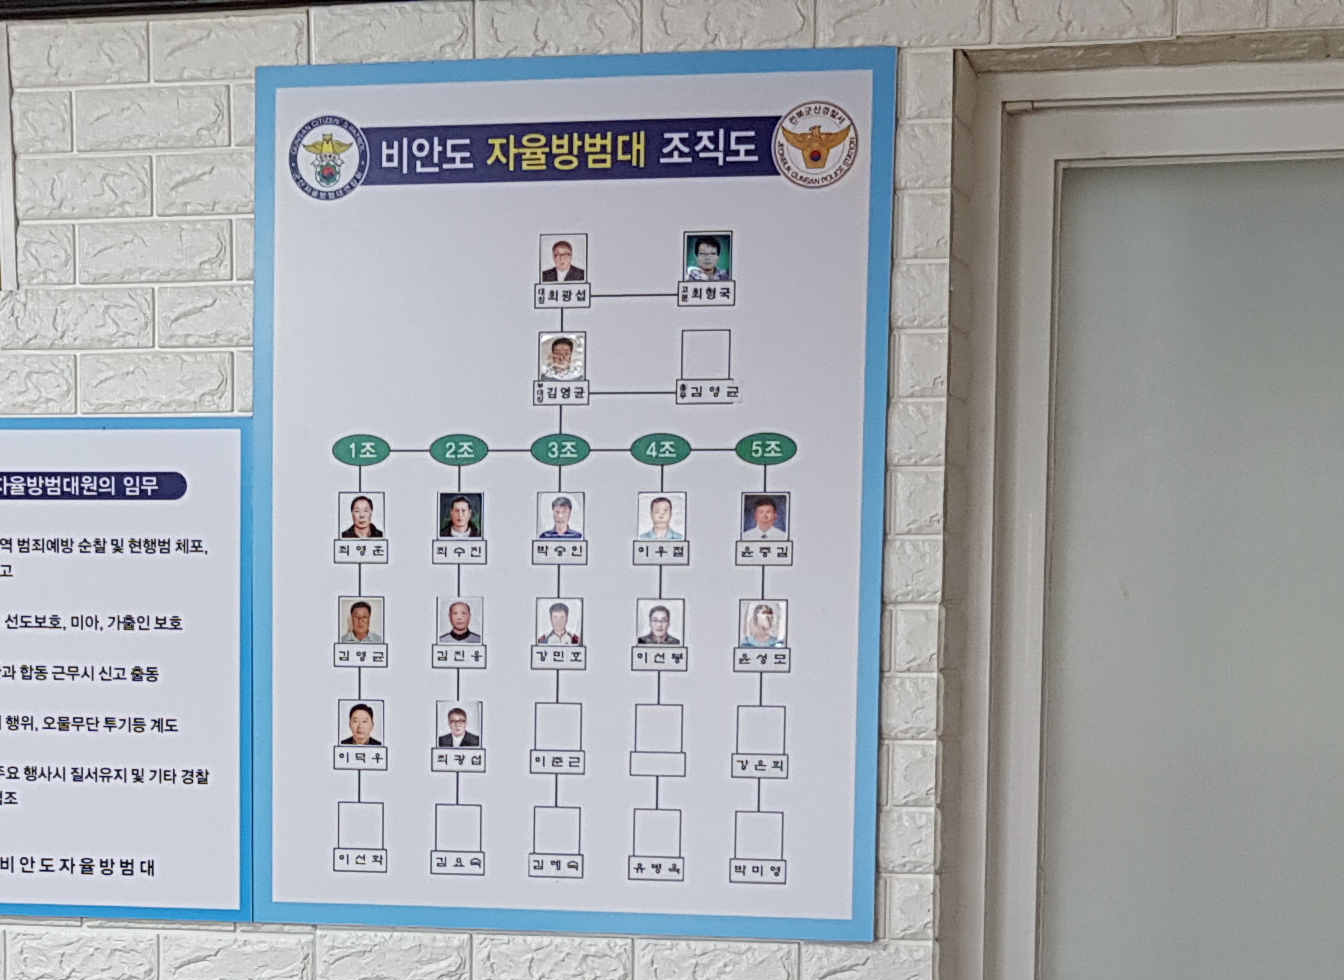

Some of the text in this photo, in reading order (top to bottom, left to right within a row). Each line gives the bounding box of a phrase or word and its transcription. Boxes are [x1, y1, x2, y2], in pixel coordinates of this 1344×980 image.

[381, 127, 759, 173] 비안도 자율방범대 조직도
[349, 442, 377, 458] 1조
[445, 442, 475, 458] 2조
[548, 442, 578, 458] 3조
[646, 442, 677, 458] 4조
[751, 441, 782, 458] 5조
[123, 476, 158, 495] 임무
[17, 537, 74, 553] 범죄예방
[78, 538, 107, 553] 순찰
[110, 538, 123, 553] 및
[128, 537, 170, 554] 현행범
[175, 538, 207, 554] 체포,
[4, 614, 66, 630] 선도보호,
[71, 614, 102, 630] 미아,
[108, 614, 150, 630] 가출인
[154, 615, 182, 629] 보호
[20, 664, 48, 680] 합동
[51, 665, 94, 680] 근무시
[98, 665, 126, 681] 신고
[130, 665, 158, 681] 출동
[5, 715, 38, 731] 행위,
[42, 716, 99, 731] 오물무단
[103, 716, 146, 732] 투기등
[150, 717, 178, 733] 계도
[24, 765, 65, 781] 행사시
[70, 766, 126, 782] 질서유지
[131, 768, 144, 783] 및
[149, 768, 176, 784] 기타
[181, 768, 209, 784] 경찰
[735, 865, 780, 876] 박미영
